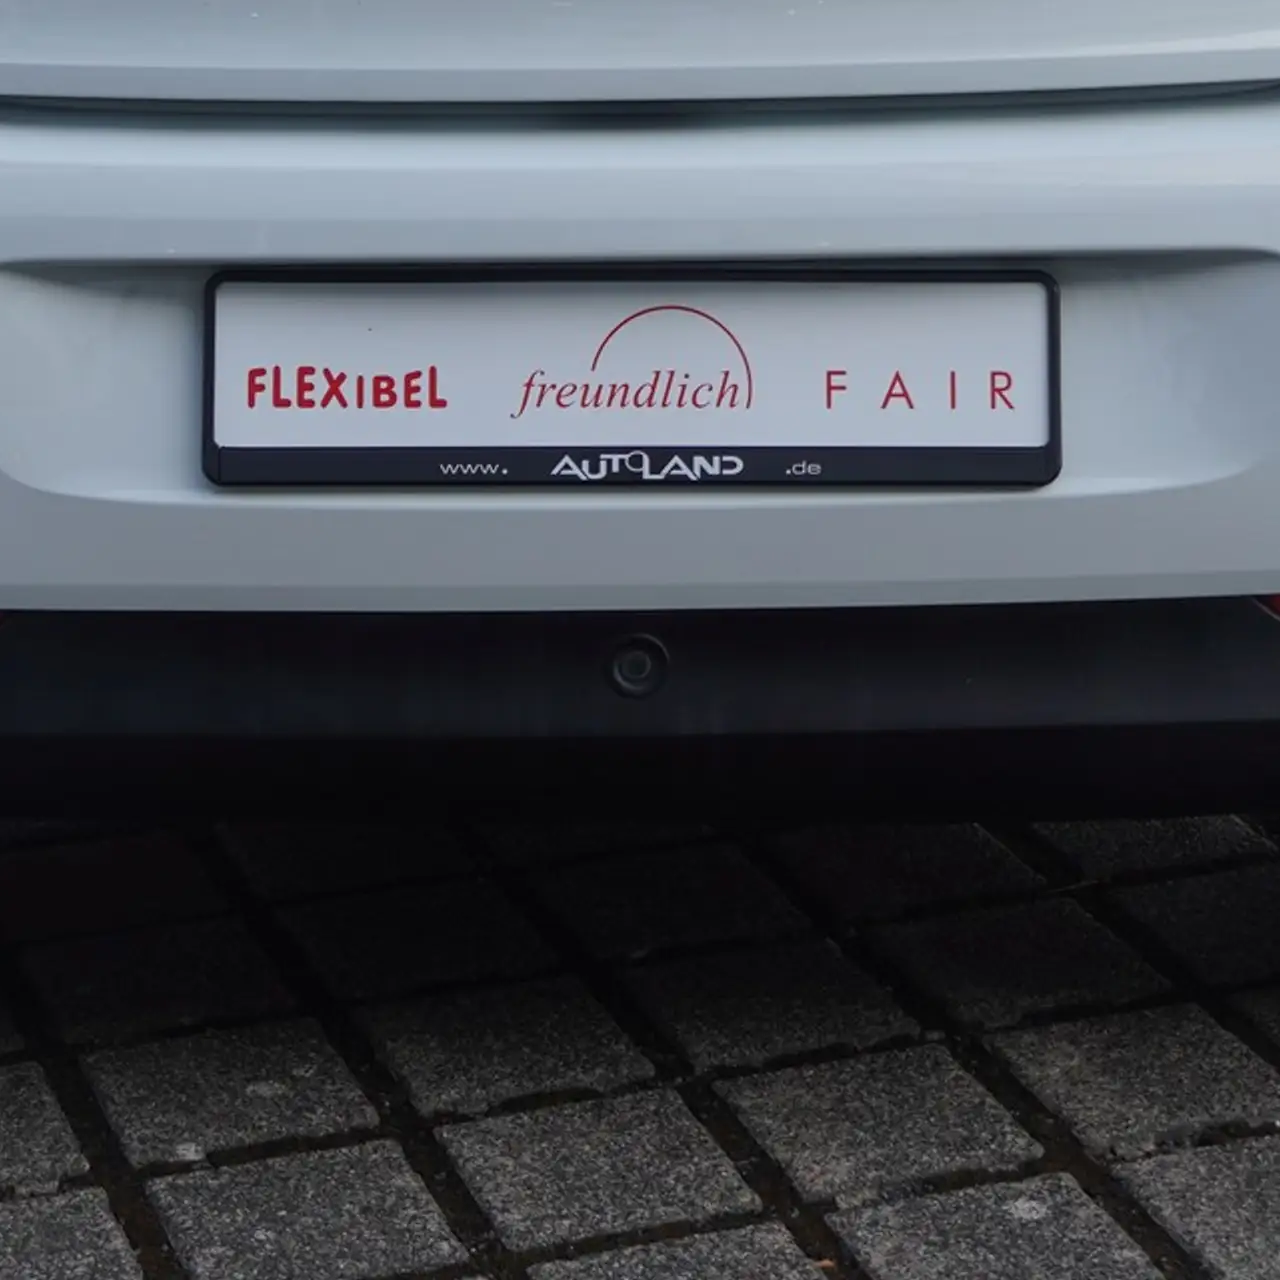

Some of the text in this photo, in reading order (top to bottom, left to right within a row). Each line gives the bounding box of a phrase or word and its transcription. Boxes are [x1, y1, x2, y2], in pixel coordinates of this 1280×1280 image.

[247, 365, 1016, 420] FLEXIBEL freundlich FAIR
[550, 450, 744, 481] AUTOLAND
